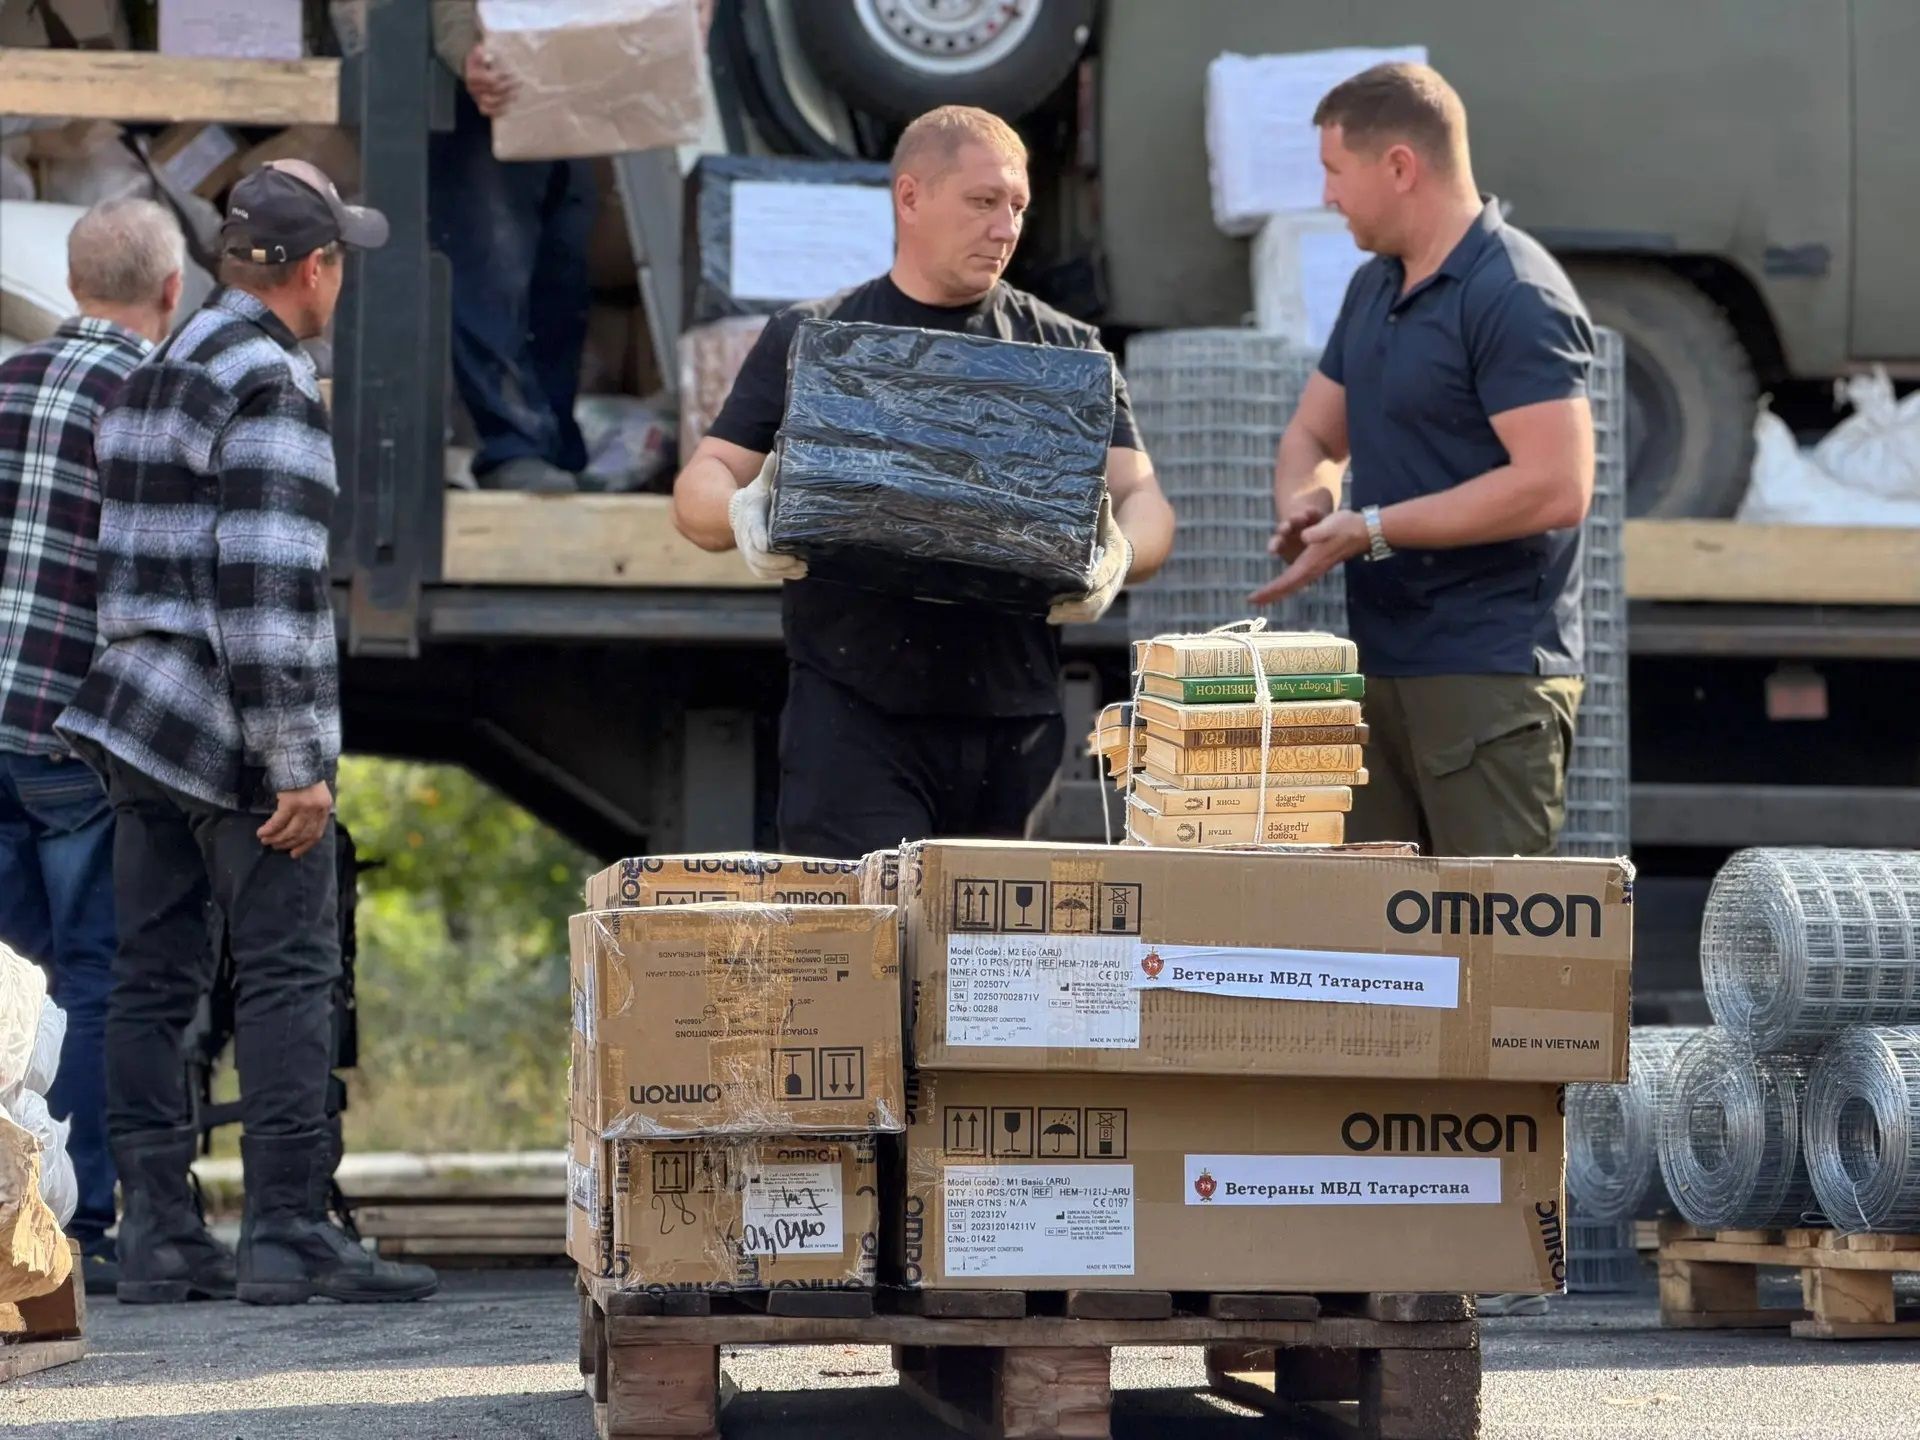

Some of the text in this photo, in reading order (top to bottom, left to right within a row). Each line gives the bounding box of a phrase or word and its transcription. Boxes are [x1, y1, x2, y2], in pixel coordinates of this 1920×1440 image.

[1195, 680, 1332, 696] Роберт Луис ИВЕНСОН
[1267, 822, 1310, 834] Драйзер
[1267, 831, 1299, 840] Теодор
[1386, 889, 1602, 939] OMRON
[951, 947, 973, 955] Model
[975, 947, 1001, 956] (Code)
[1008, 948, 1019, 956] M2
[1038, 948, 1062, 957] (ARU)
[950, 957, 969, 966] QTY
[978, 958, 987, 966] 10
[1038, 958, 1055, 967] REF
[950, 968, 978, 976] INNER
[1013, 969, 1031, 977] N/A
[1172, 967, 1425, 992] Ветераны МВД Татарстана
[952, 980, 1010, 989] LOT 202507V
[953, 992, 1040, 1001] SN 202507002871V
[973, 1004, 998, 1013] 00288
[1491, 1037, 1600, 1050] MADE IN VIETNAM
[629, 1083, 722, 1105] OMRON
[1341, 1112, 1538, 1153] OMRON
[947, 1177, 972, 1186] Model
[973, 1177, 1000, 1186] (code)
[1006, 1178, 1018, 1186] M1
[1021, 1178, 1044, 1186] Basic
[1045, 1177, 1071, 1186] (ARU)
[947, 1189, 967, 1197] QTY
[975, 1189, 985, 1197] 10
[986, 1188, 1029, 1197] PCS/CTN
[1033, 1188, 1050, 1196] REF
[1225, 1181, 1470, 1199] Ветераны МВД Татарстана
[947, 1199, 975, 1207] INNER
[977, 1199, 1002, 1207] CTNS
[1009, 1199, 1027, 1207] N/A
[1108, 1198, 1128, 1207] 0197
[971, 1210, 1007, 1218] 202312V
[971, 1222, 1036, 1230] 202312014211V
[971, 1235, 996, 1243] 01422
